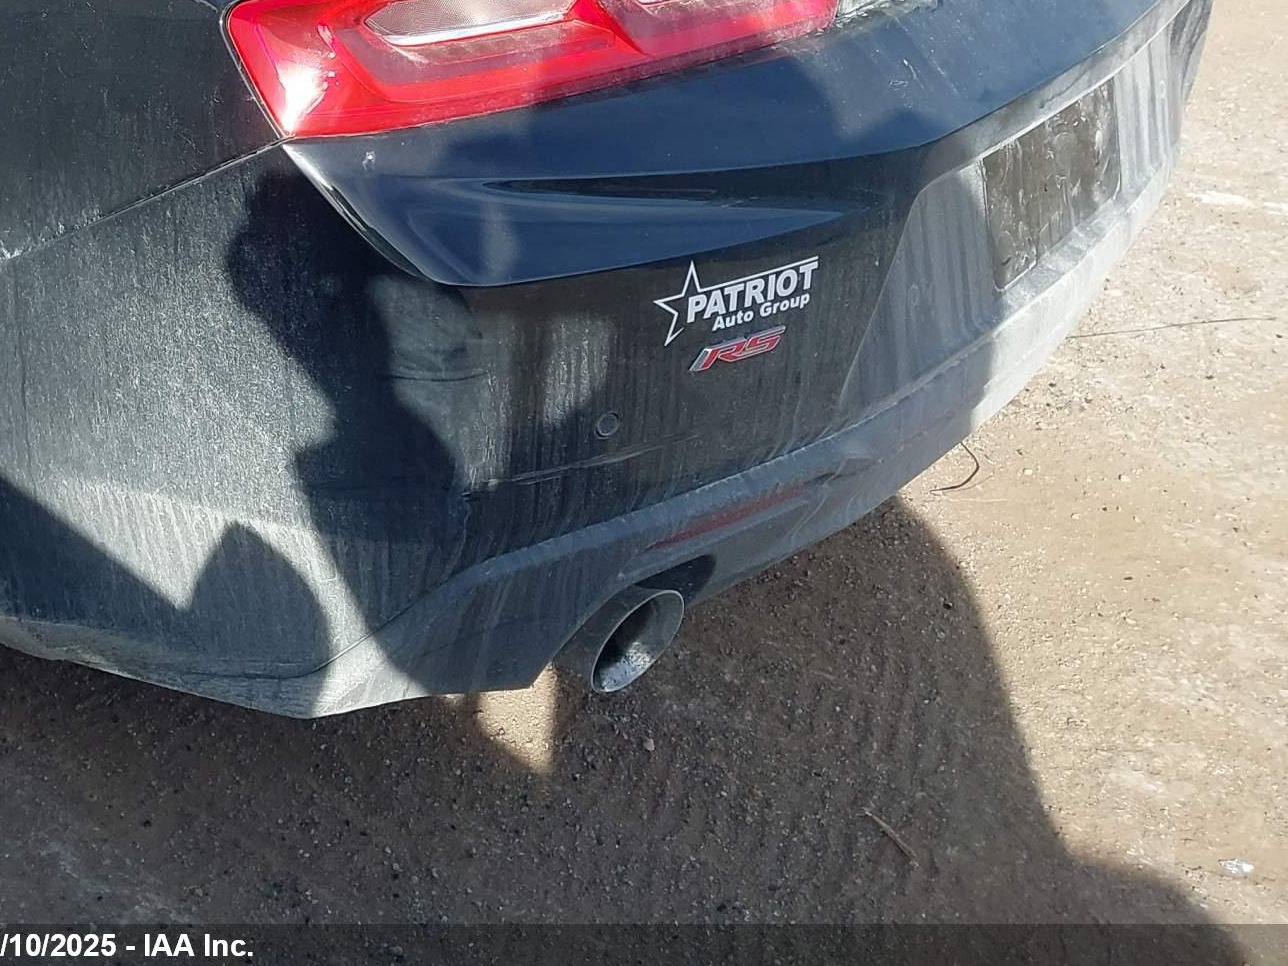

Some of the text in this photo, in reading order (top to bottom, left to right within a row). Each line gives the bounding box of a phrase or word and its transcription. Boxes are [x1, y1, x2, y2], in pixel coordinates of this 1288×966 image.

[686, 261, 819, 323] PATRIOT
[712, 293, 810, 332] Auto Group
[692, 327, 785, 371] RS
